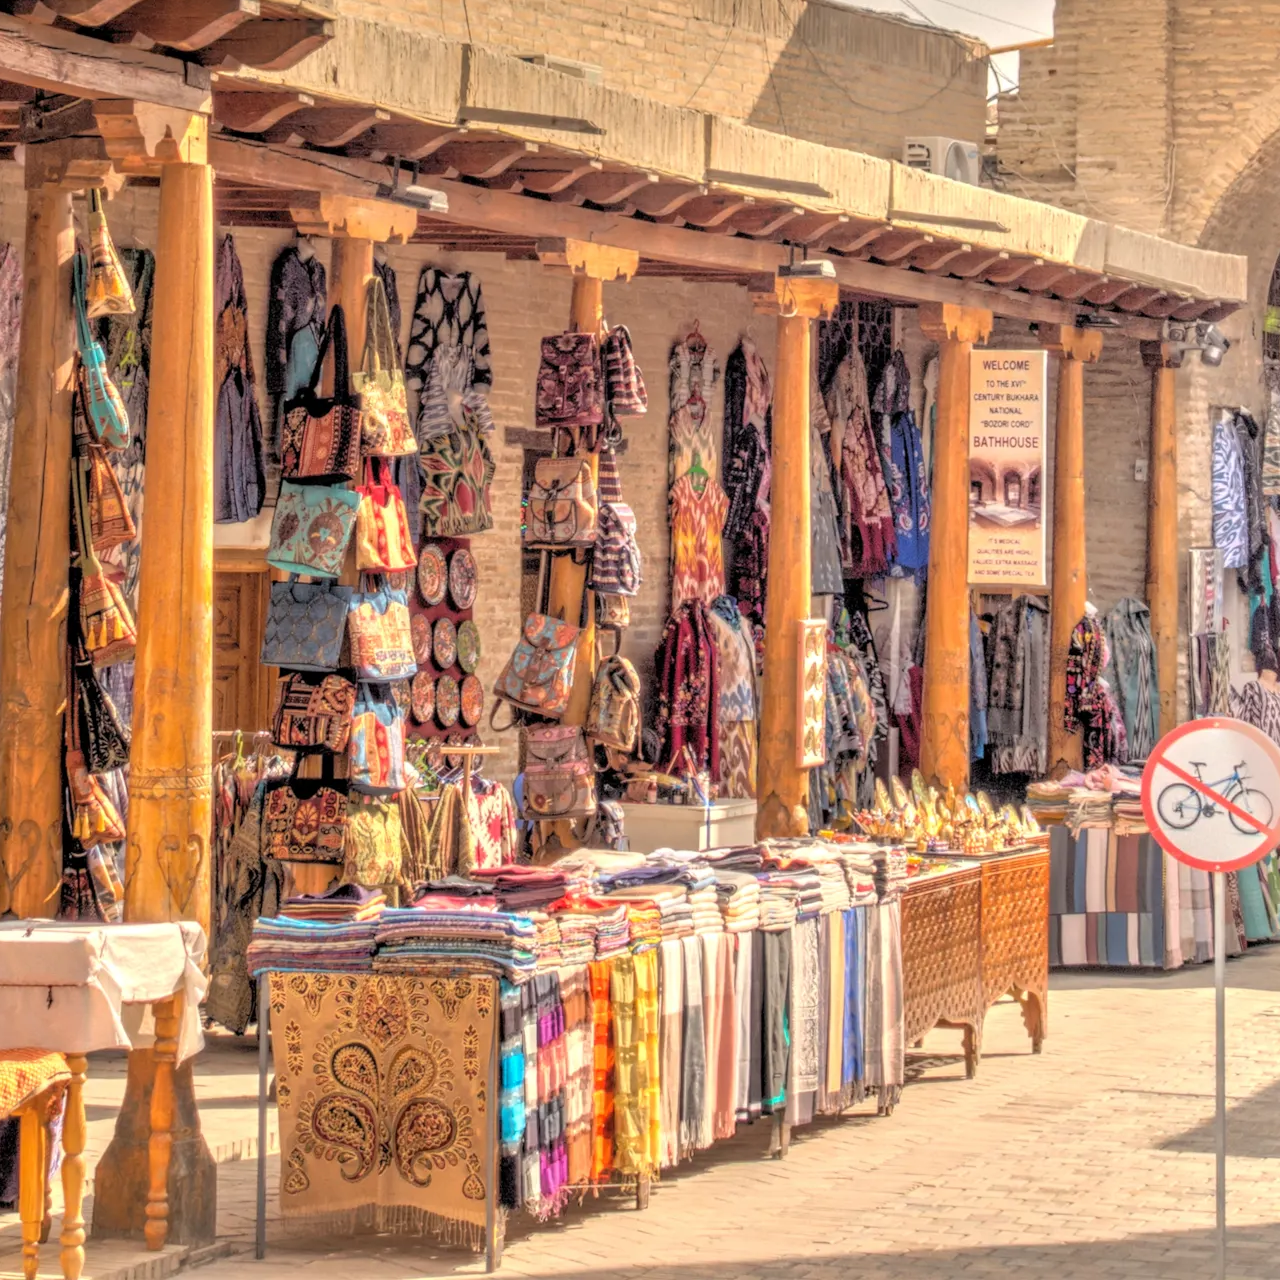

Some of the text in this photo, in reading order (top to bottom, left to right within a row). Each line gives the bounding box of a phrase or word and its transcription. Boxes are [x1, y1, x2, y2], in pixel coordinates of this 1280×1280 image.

[983, 360, 1030, 371] WELCOME
[986, 380, 995, 388] TO
[997, 380, 1009, 388] THE
[973, 393, 1039, 401] CENTURY BUKHARA
[989, 407, 1023, 415] NATIONAL
[973, 436, 1039, 448] BATHHOUSE
